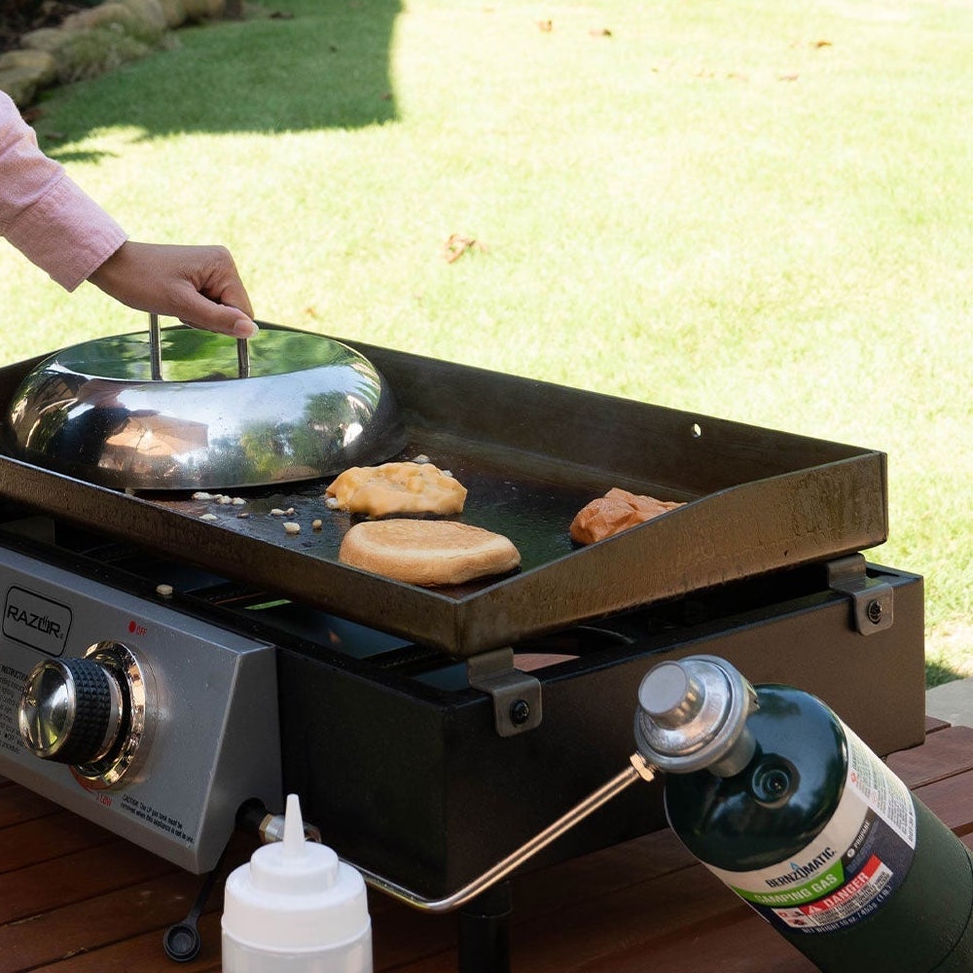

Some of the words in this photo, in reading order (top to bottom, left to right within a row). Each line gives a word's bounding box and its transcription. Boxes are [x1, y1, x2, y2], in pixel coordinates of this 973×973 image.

[7, 604, 61, 639] RAZOR
[136, 626, 147, 636] OFF
[99, 794, 113, 807] LOW
[854, 820, 871, 849] PROPANE
[765, 846, 835, 889] BERNZOMATIC
[754, 887, 812, 904] CAMPING
[811, 873, 838, 894] GAS
[823, 872, 870, 910] DANGER
